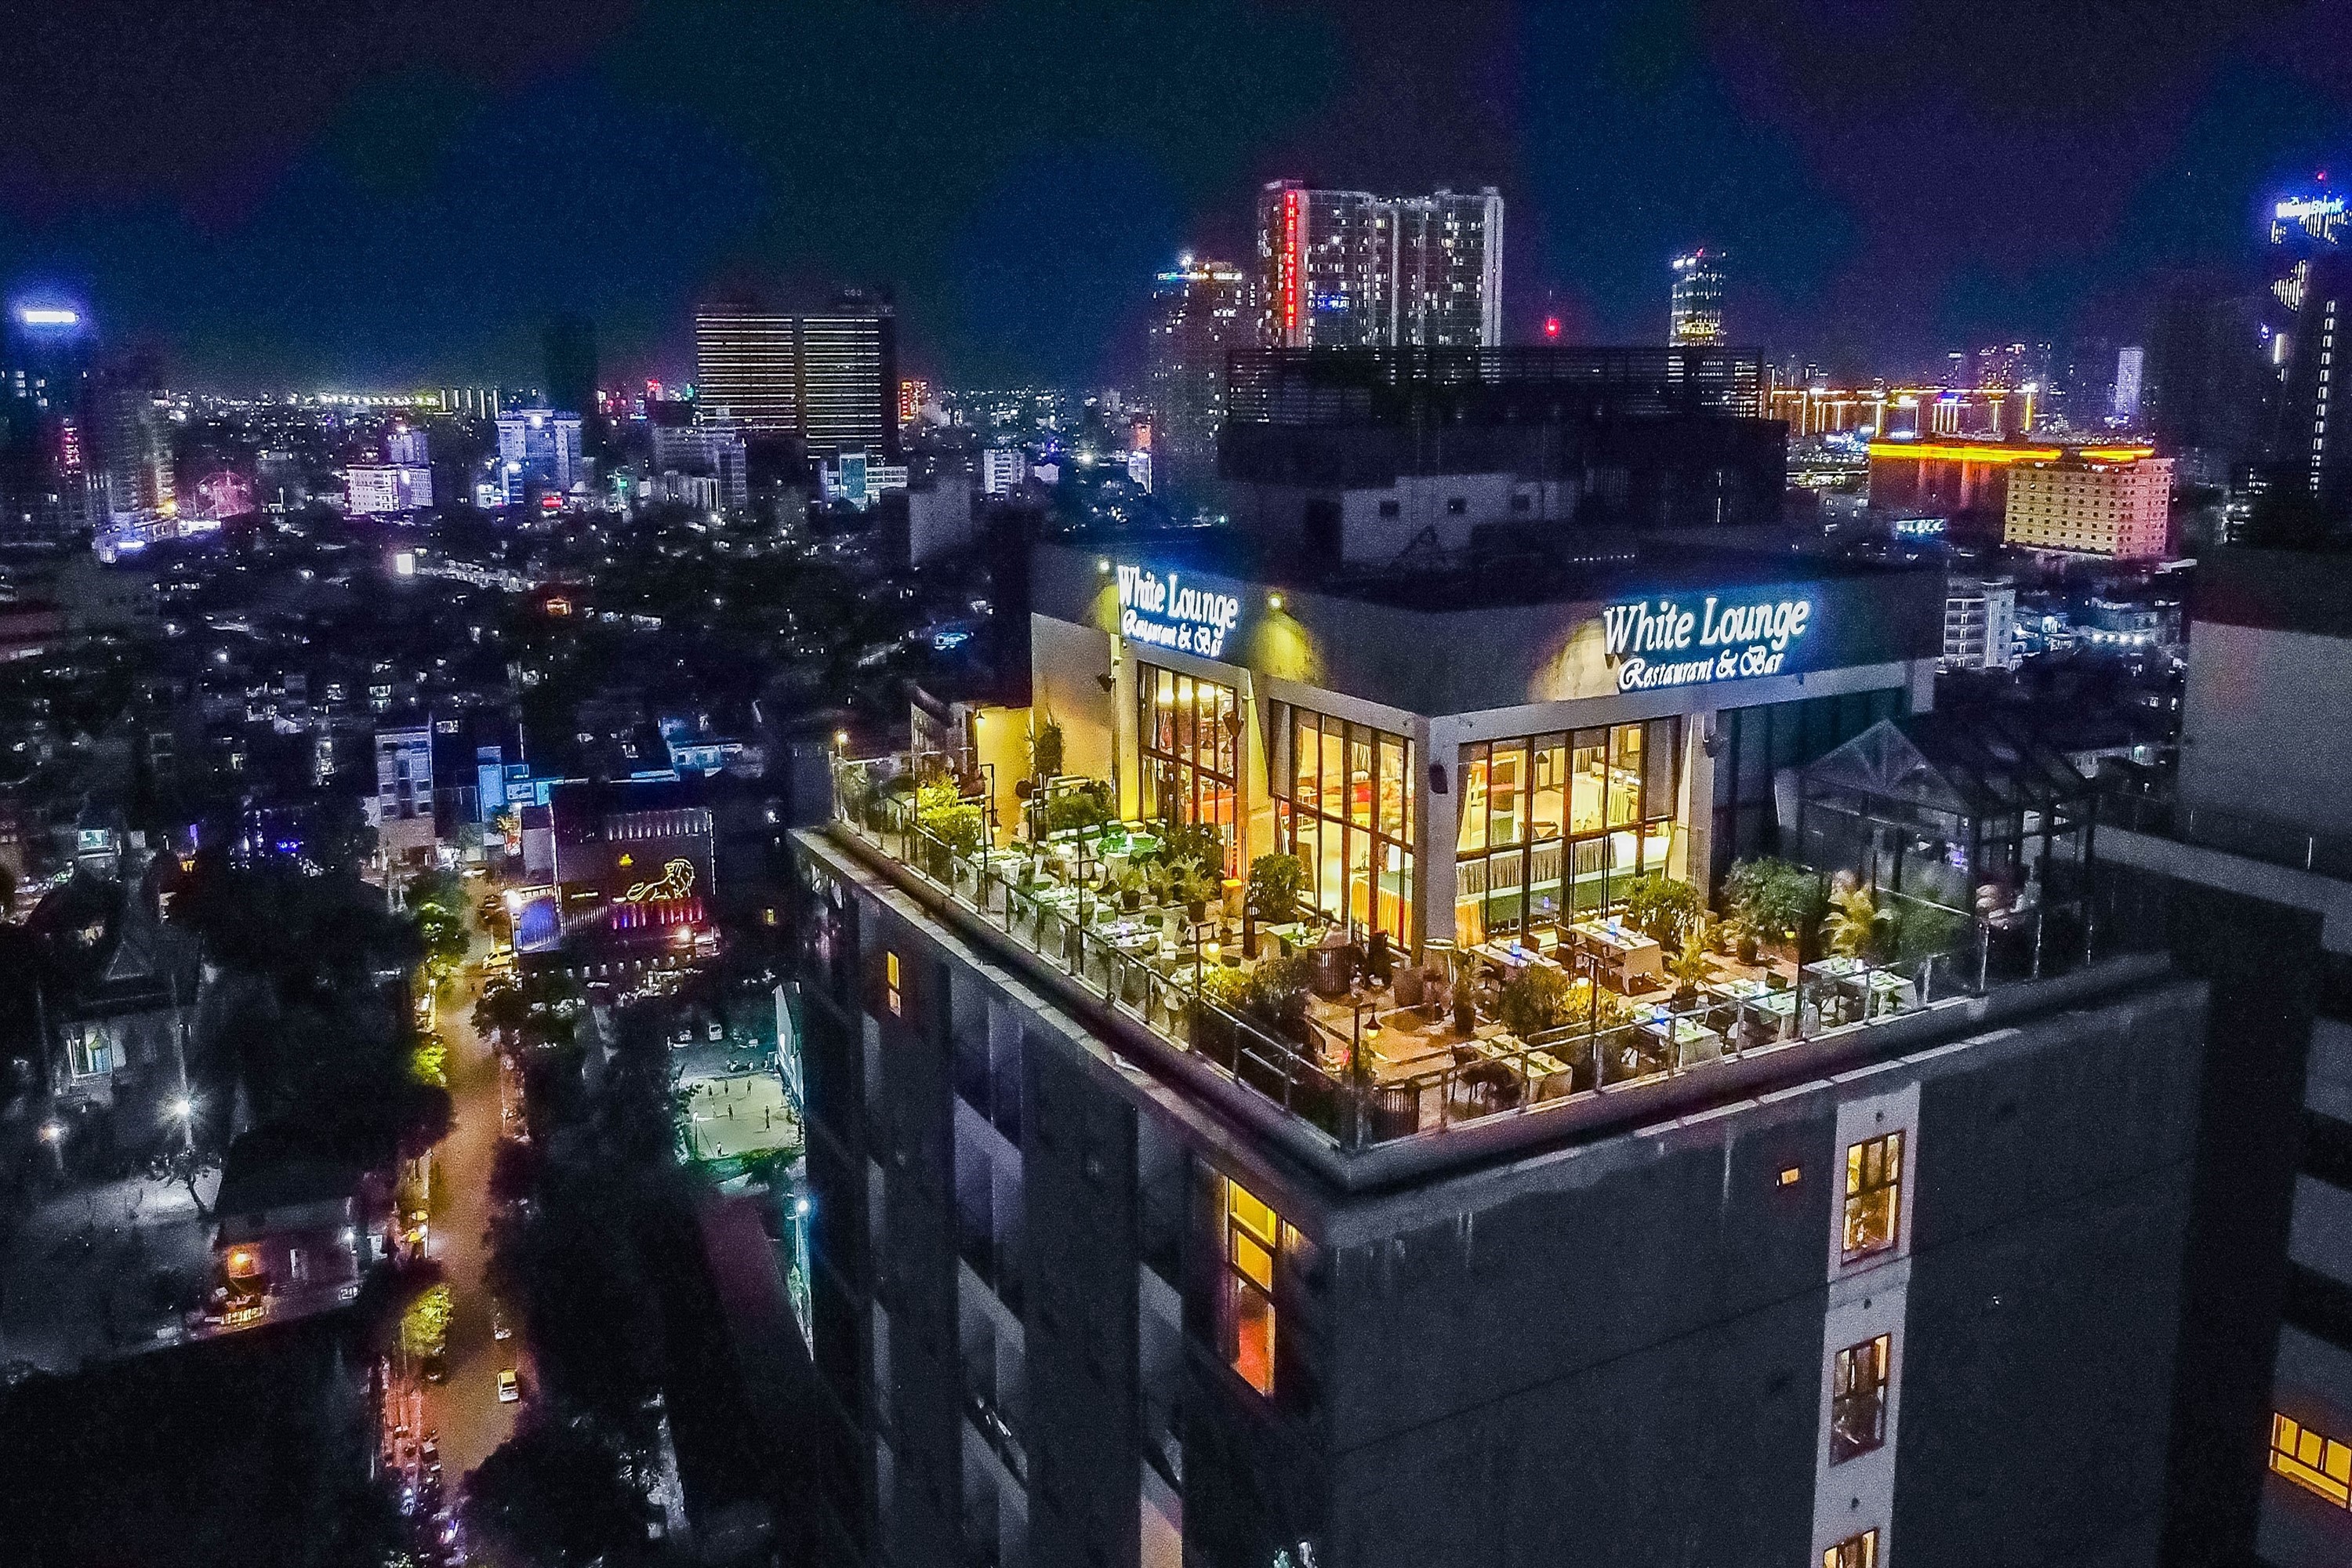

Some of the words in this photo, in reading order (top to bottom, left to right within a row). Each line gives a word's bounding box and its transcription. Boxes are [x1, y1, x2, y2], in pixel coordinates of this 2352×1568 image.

[1287, 194, 1296, 230] THE
[1287, 241, 1296, 326] SKYLINE
[1117, 564, 1166, 613] White
[1168, 574, 1239, 640] Lounge
[1604, 601, 1694, 655] White
[1699, 597, 1809, 652] Lounge
[1178, 622, 1192, 649] &
[1194, 625, 1223, 657] Bar
[1618, 657, 1715, 689] Restaurant
[1715, 648, 1739, 679] &
[1740, 645, 1784, 677] Bar
